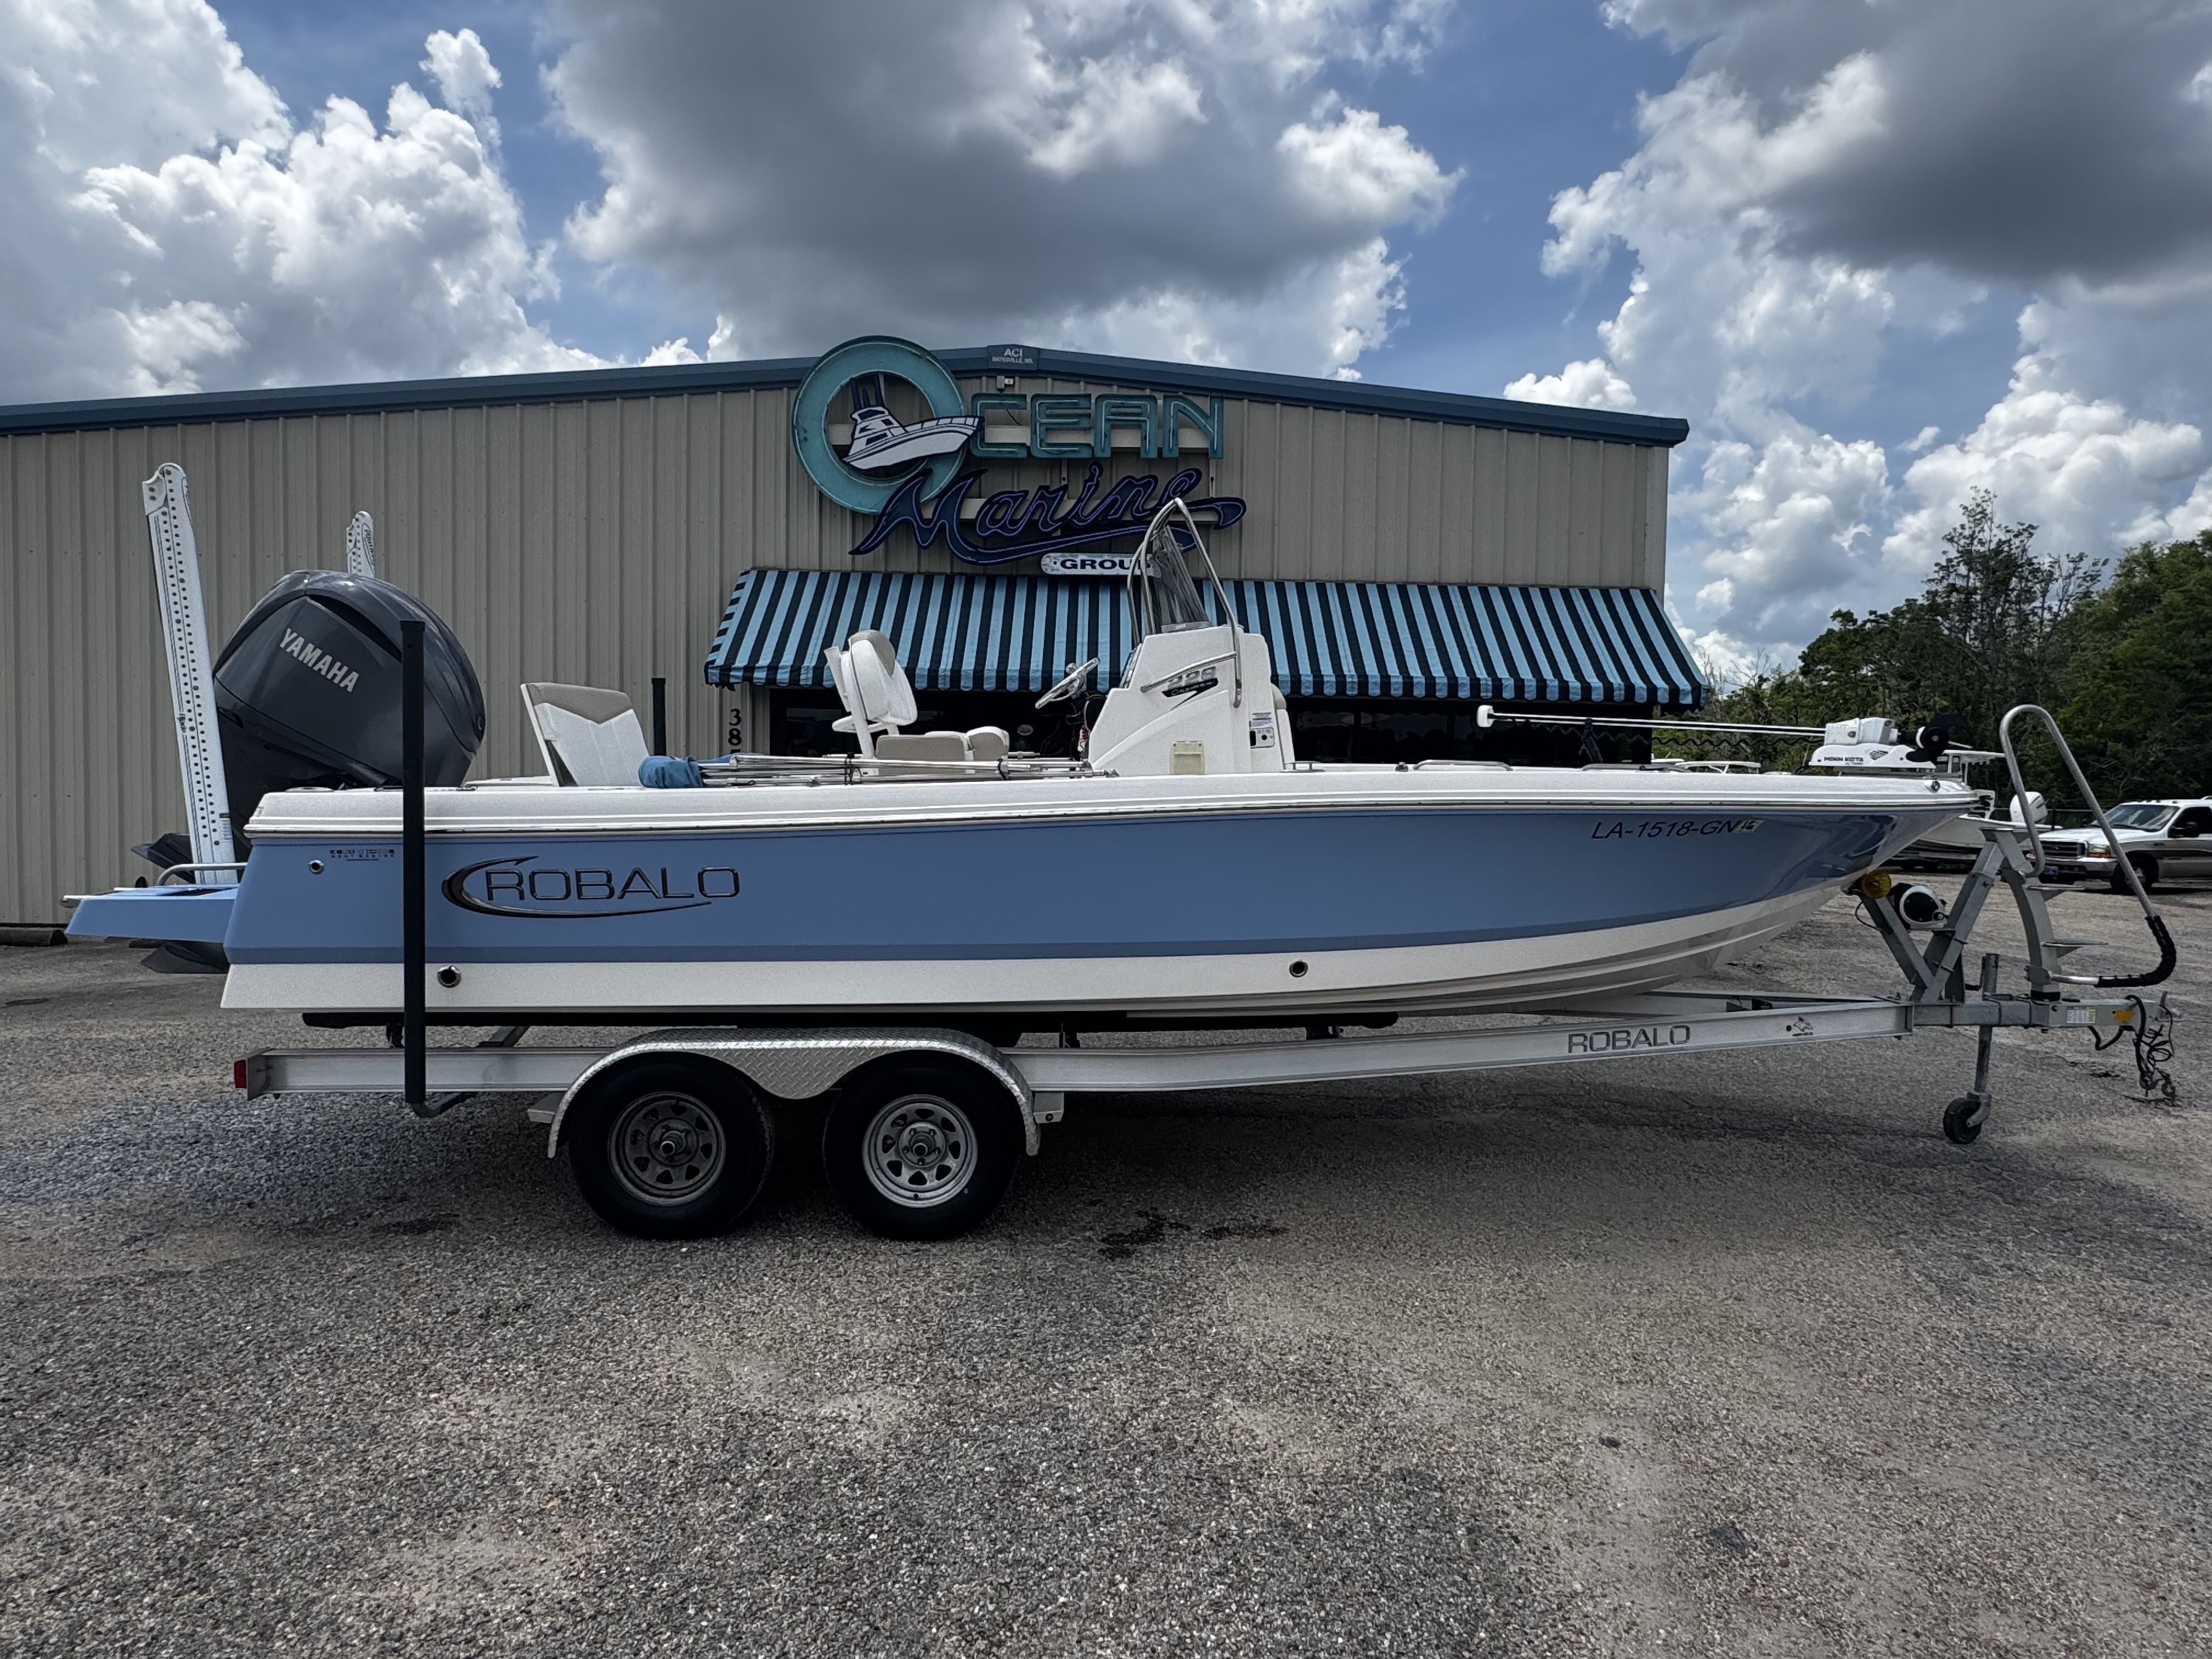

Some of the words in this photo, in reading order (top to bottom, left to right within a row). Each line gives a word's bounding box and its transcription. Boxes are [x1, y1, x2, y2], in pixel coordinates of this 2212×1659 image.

[1003, 348, 1023, 357] ACI
[793, 335, 1224, 515] OCEAN
[848, 462, 1246, 565] Marine
[280, 628, 360, 692] YAMAHA
[728, 708, 742, 754] 38
[485, 866, 740, 901] ROBALO
[1568, 1025, 1691, 1053] ROBALO
